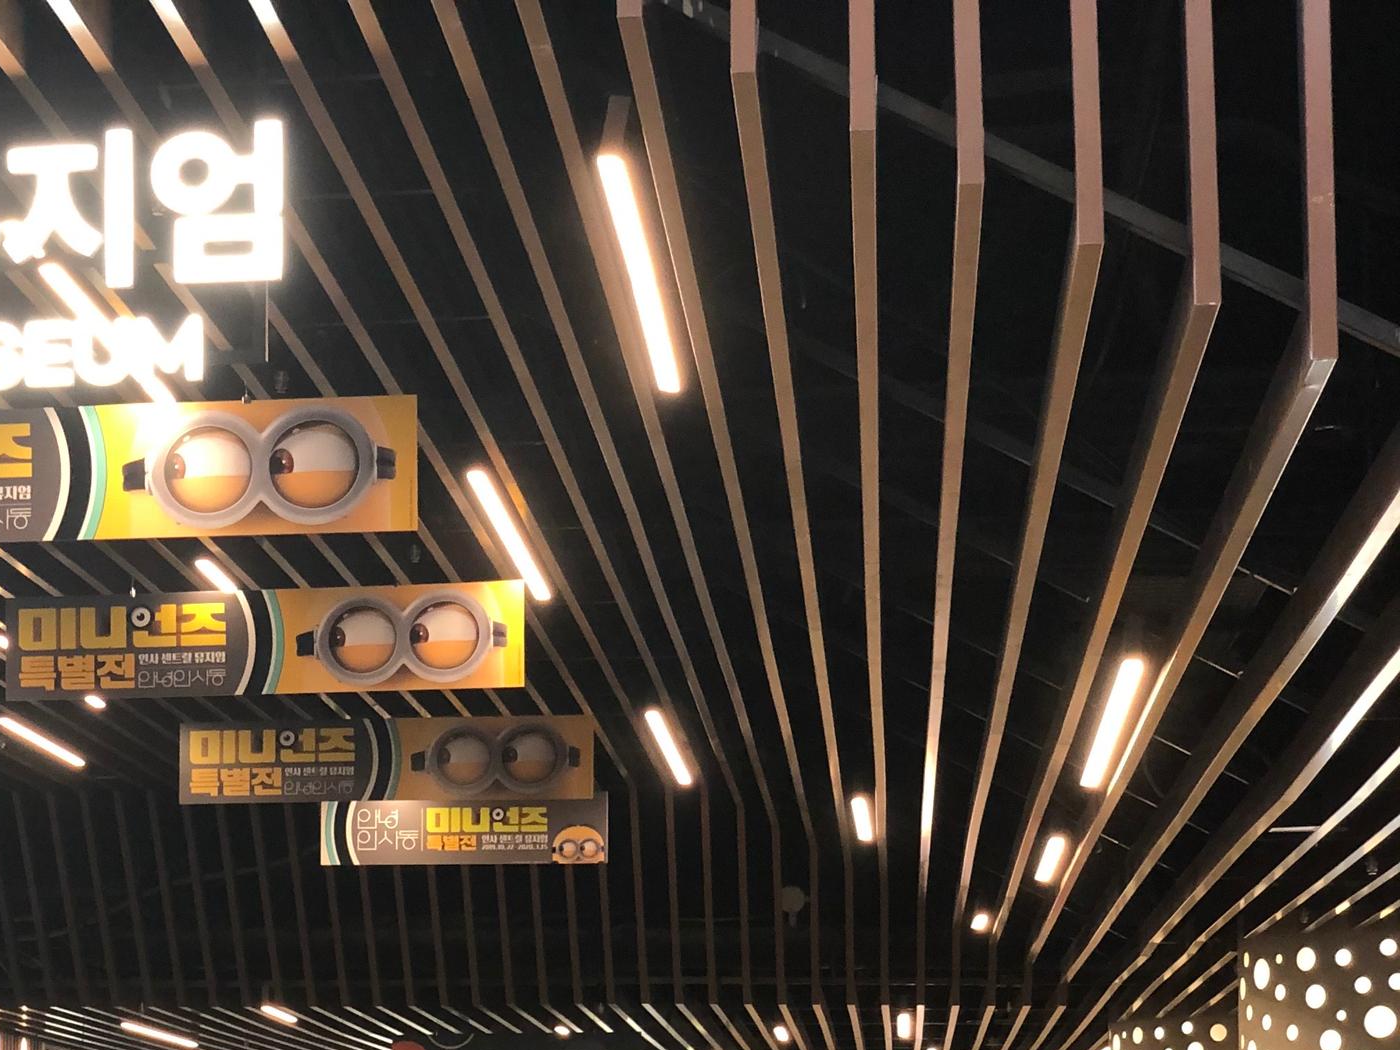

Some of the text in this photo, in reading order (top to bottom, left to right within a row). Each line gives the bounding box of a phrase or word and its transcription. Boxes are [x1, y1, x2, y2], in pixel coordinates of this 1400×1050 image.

[18, 602, 227, 651] 미니언즈
[18, 653, 136, 691] 특별전
[138, 652, 159, 665] 인사
[189, 727, 356, 764] 미니언즈
[189, 767, 283, 797] 특별전
[426, 806, 549, 834] 미니언즈
[426, 834, 477, 852] 특별전
